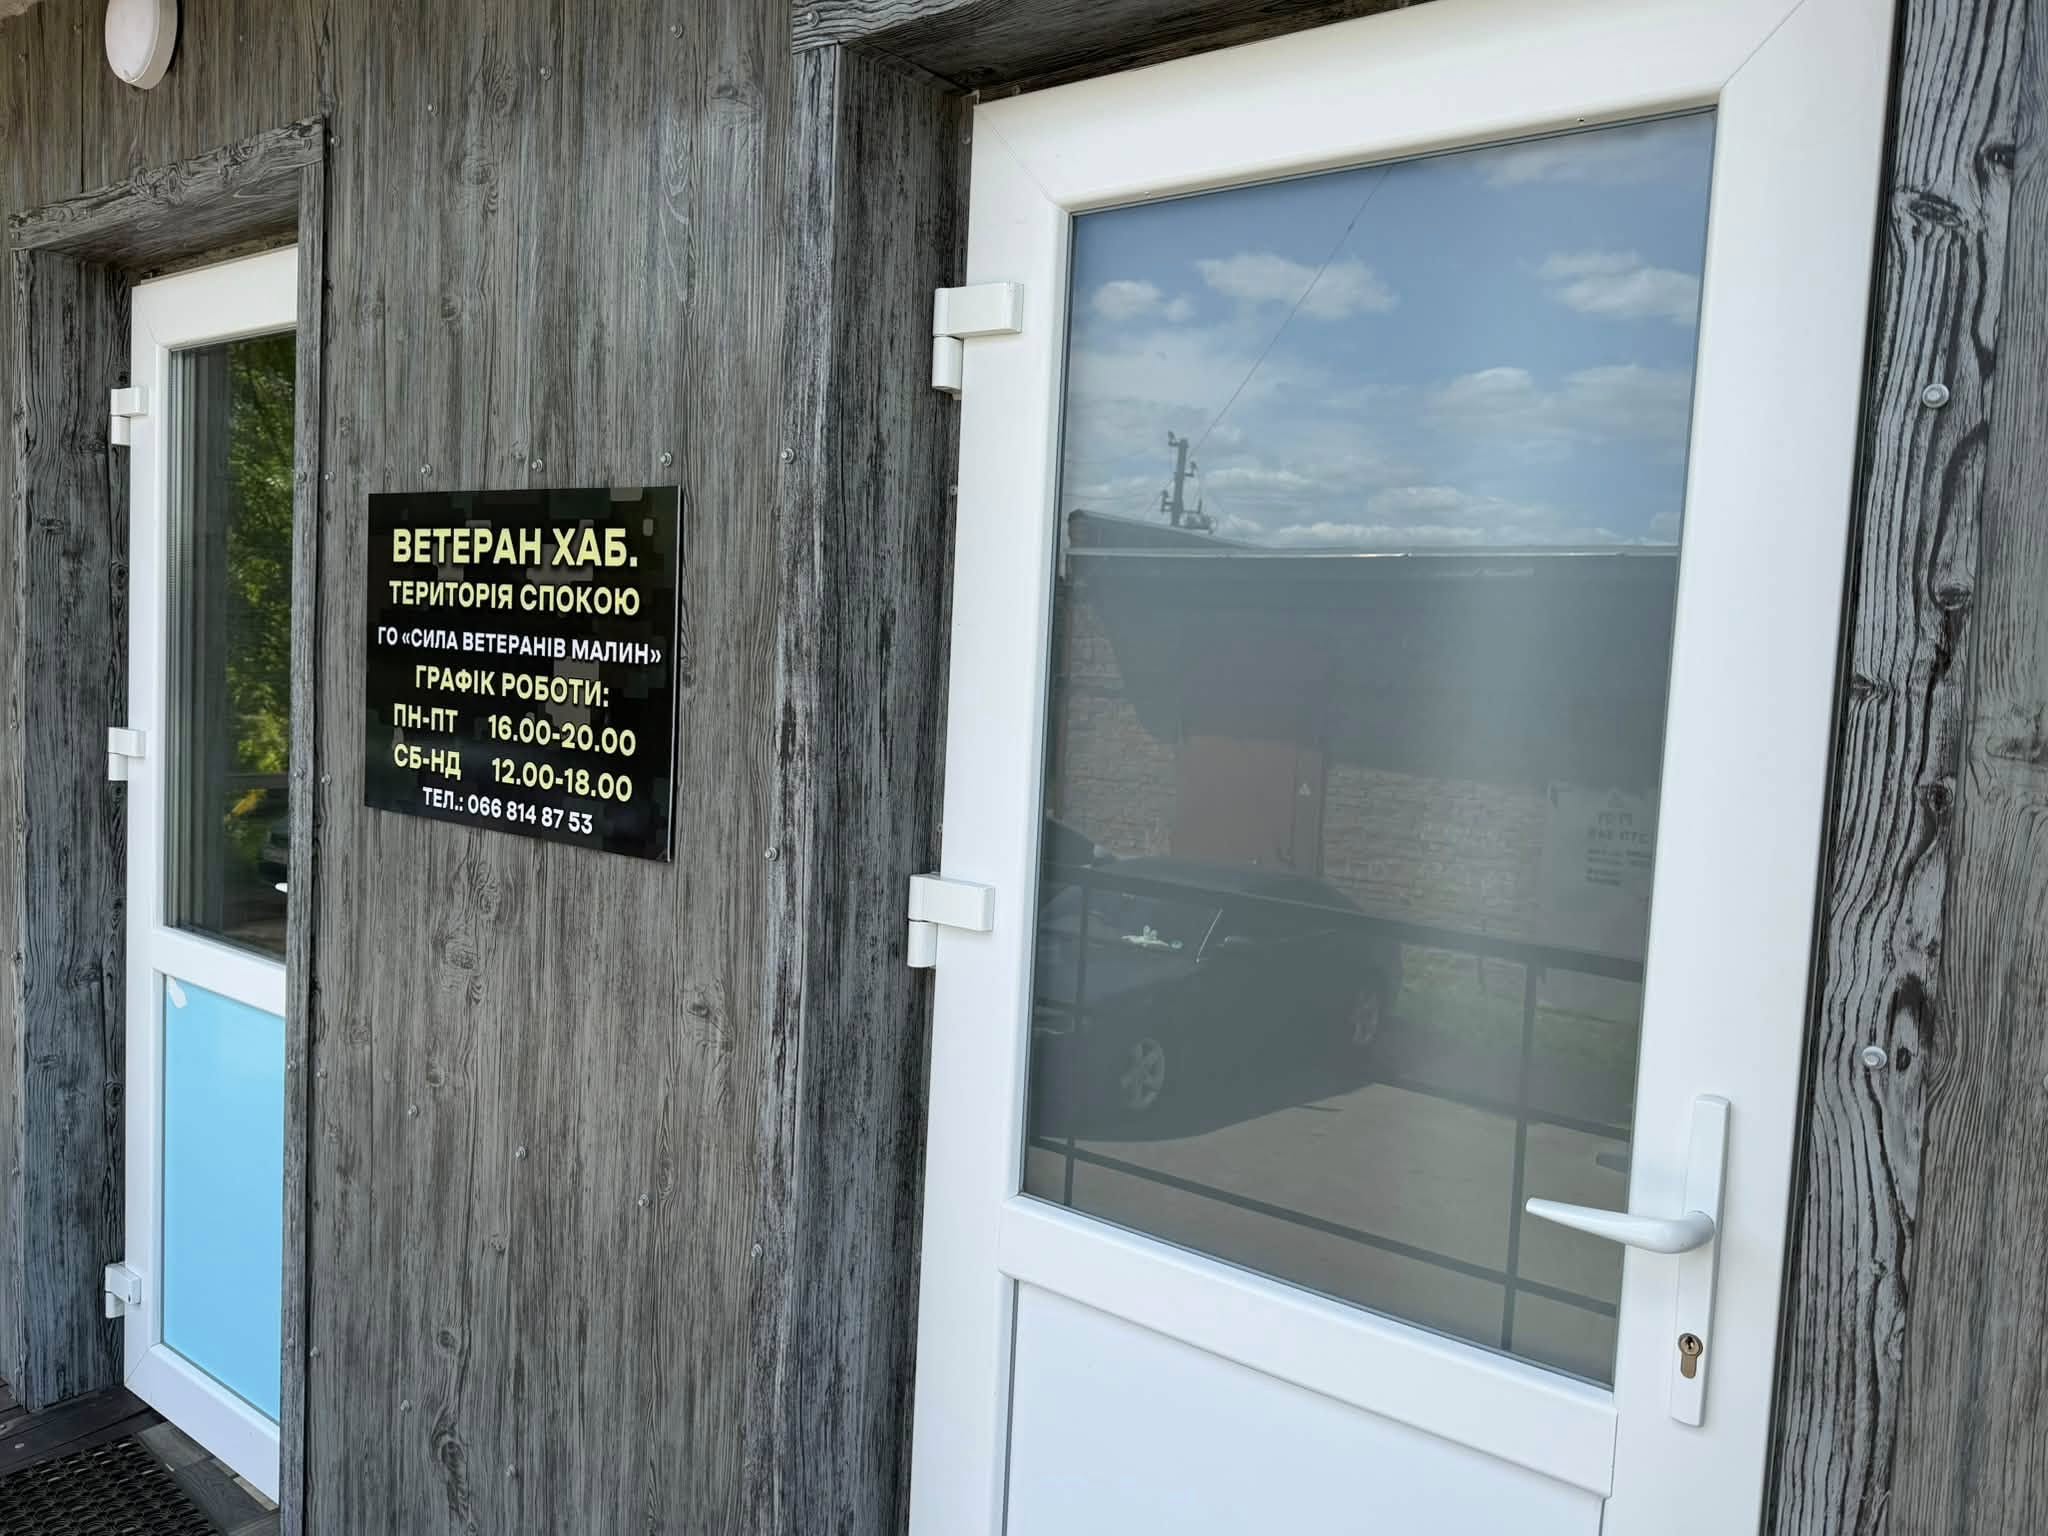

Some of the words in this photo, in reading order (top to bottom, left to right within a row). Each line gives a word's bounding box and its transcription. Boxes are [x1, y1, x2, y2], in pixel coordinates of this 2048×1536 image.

[392, 528, 541, 565] ВЕТЕРАН
[552, 528, 638, 568] ХАБ.
[389, 580, 512, 610] ТЕРИТОРІЯ
[520, 585, 640, 616] СПОКОЮ
[378, 627, 398, 645] ГО
[402, 629, 458, 650] «СИЛА
[463, 633, 566, 659] ВЕТЕРАНІВ
[572, 640, 661, 664] МАЛИН»
[415, 665, 495, 696] ГРАФІК
[502, 673, 609, 707] РОБОТИ:
[394, 703, 458, 732] ПН-ПТ
[488, 715, 636, 756] 16.00-20.00
[394, 744, 461, 780] СБ-НД
[492, 758, 632, 802] 12.00-18.00
[422, 787, 463, 811] ТЕЛ.:
[468, 794, 502, 818] 066
[507, 801, 536, 824] 814
[541, 808, 564, 829] 87
[568, 812, 593, 834] 53
